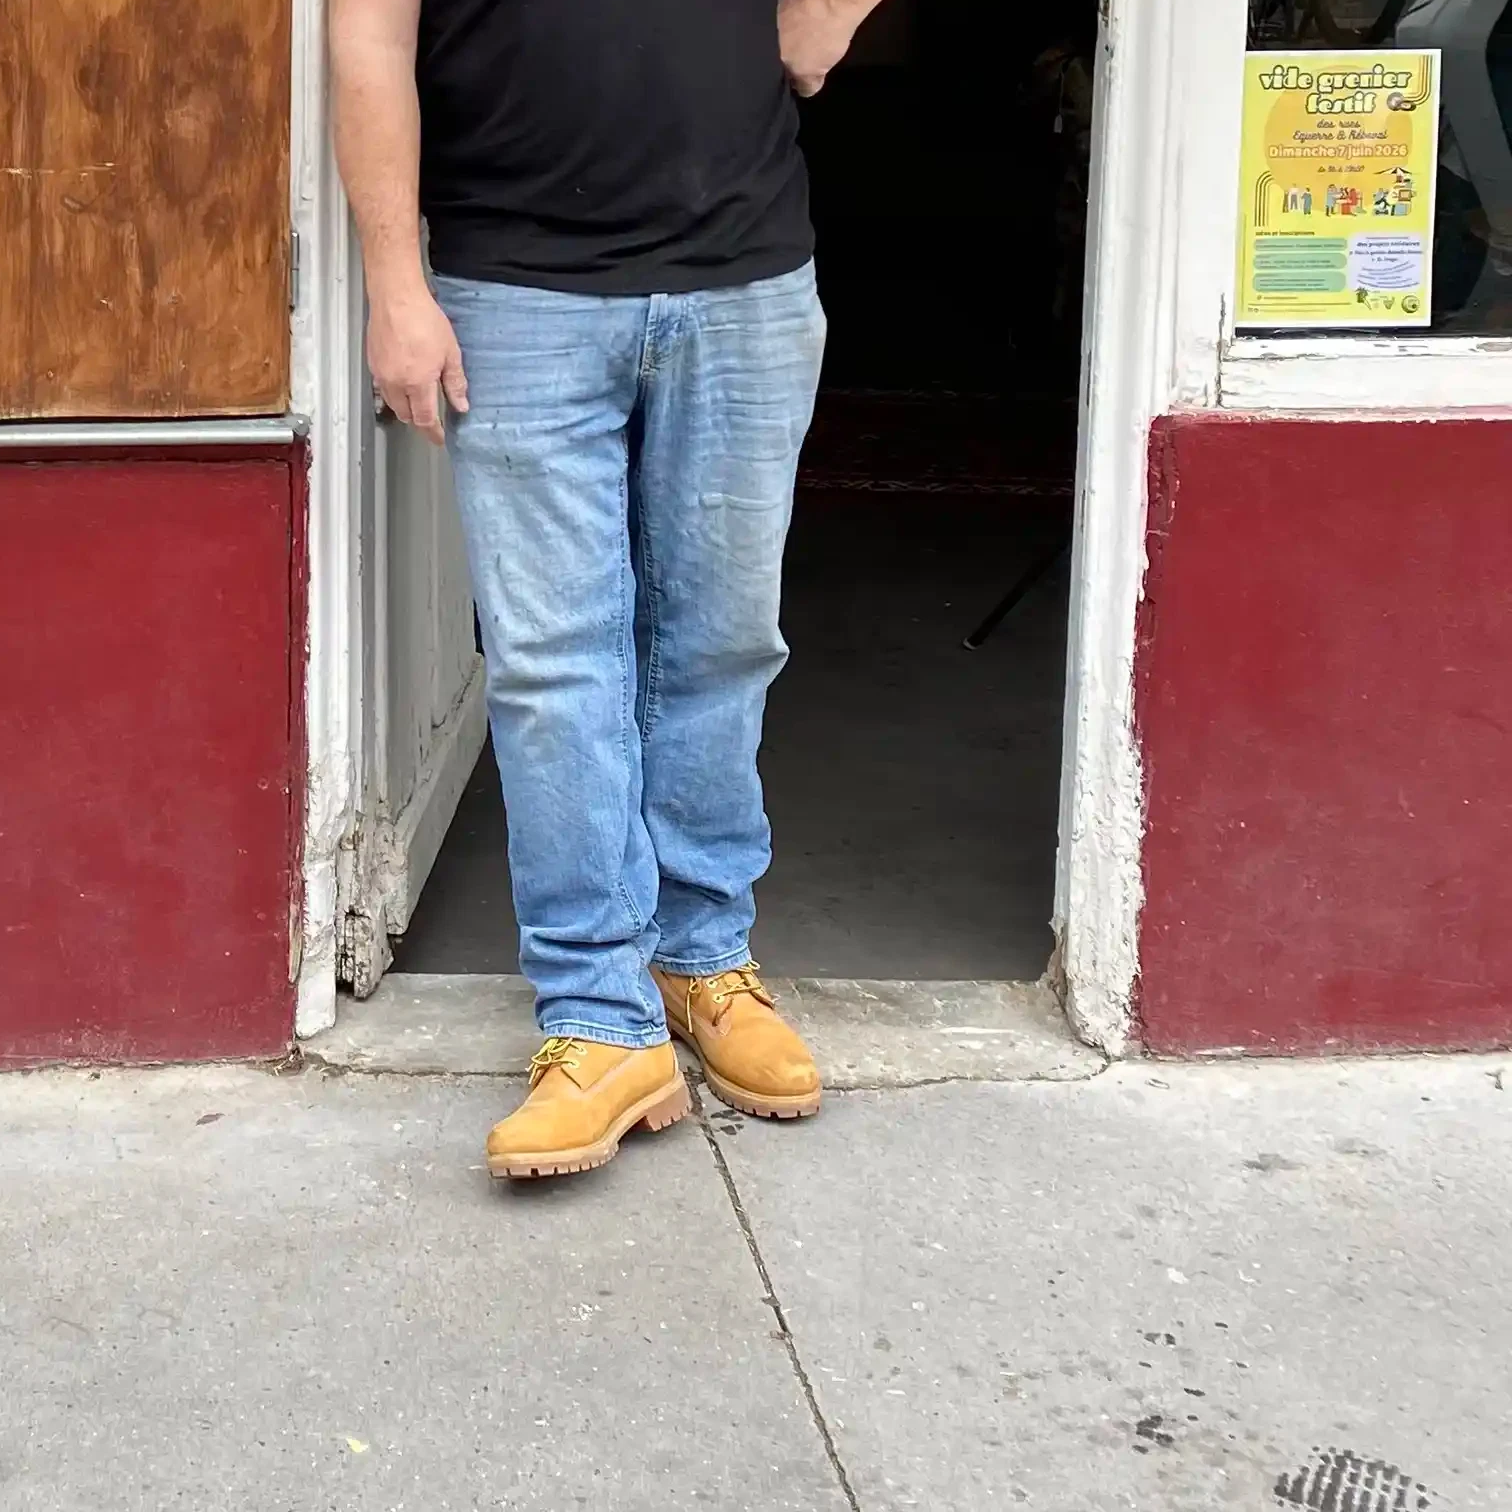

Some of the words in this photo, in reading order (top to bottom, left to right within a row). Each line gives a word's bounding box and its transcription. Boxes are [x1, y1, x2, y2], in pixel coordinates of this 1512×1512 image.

[1259, 64, 1313, 89] vide
[1317, 64, 1412, 94] grenier
[1306, 91, 1377, 114] festif
[1317, 119, 1335, 128] des
[1269, 144, 1336, 158] Dimanche
[1337, 145, 1347, 157] 7
[1346, 144, 1373, 160] juin
[1373, 145, 1408, 157] 2026
